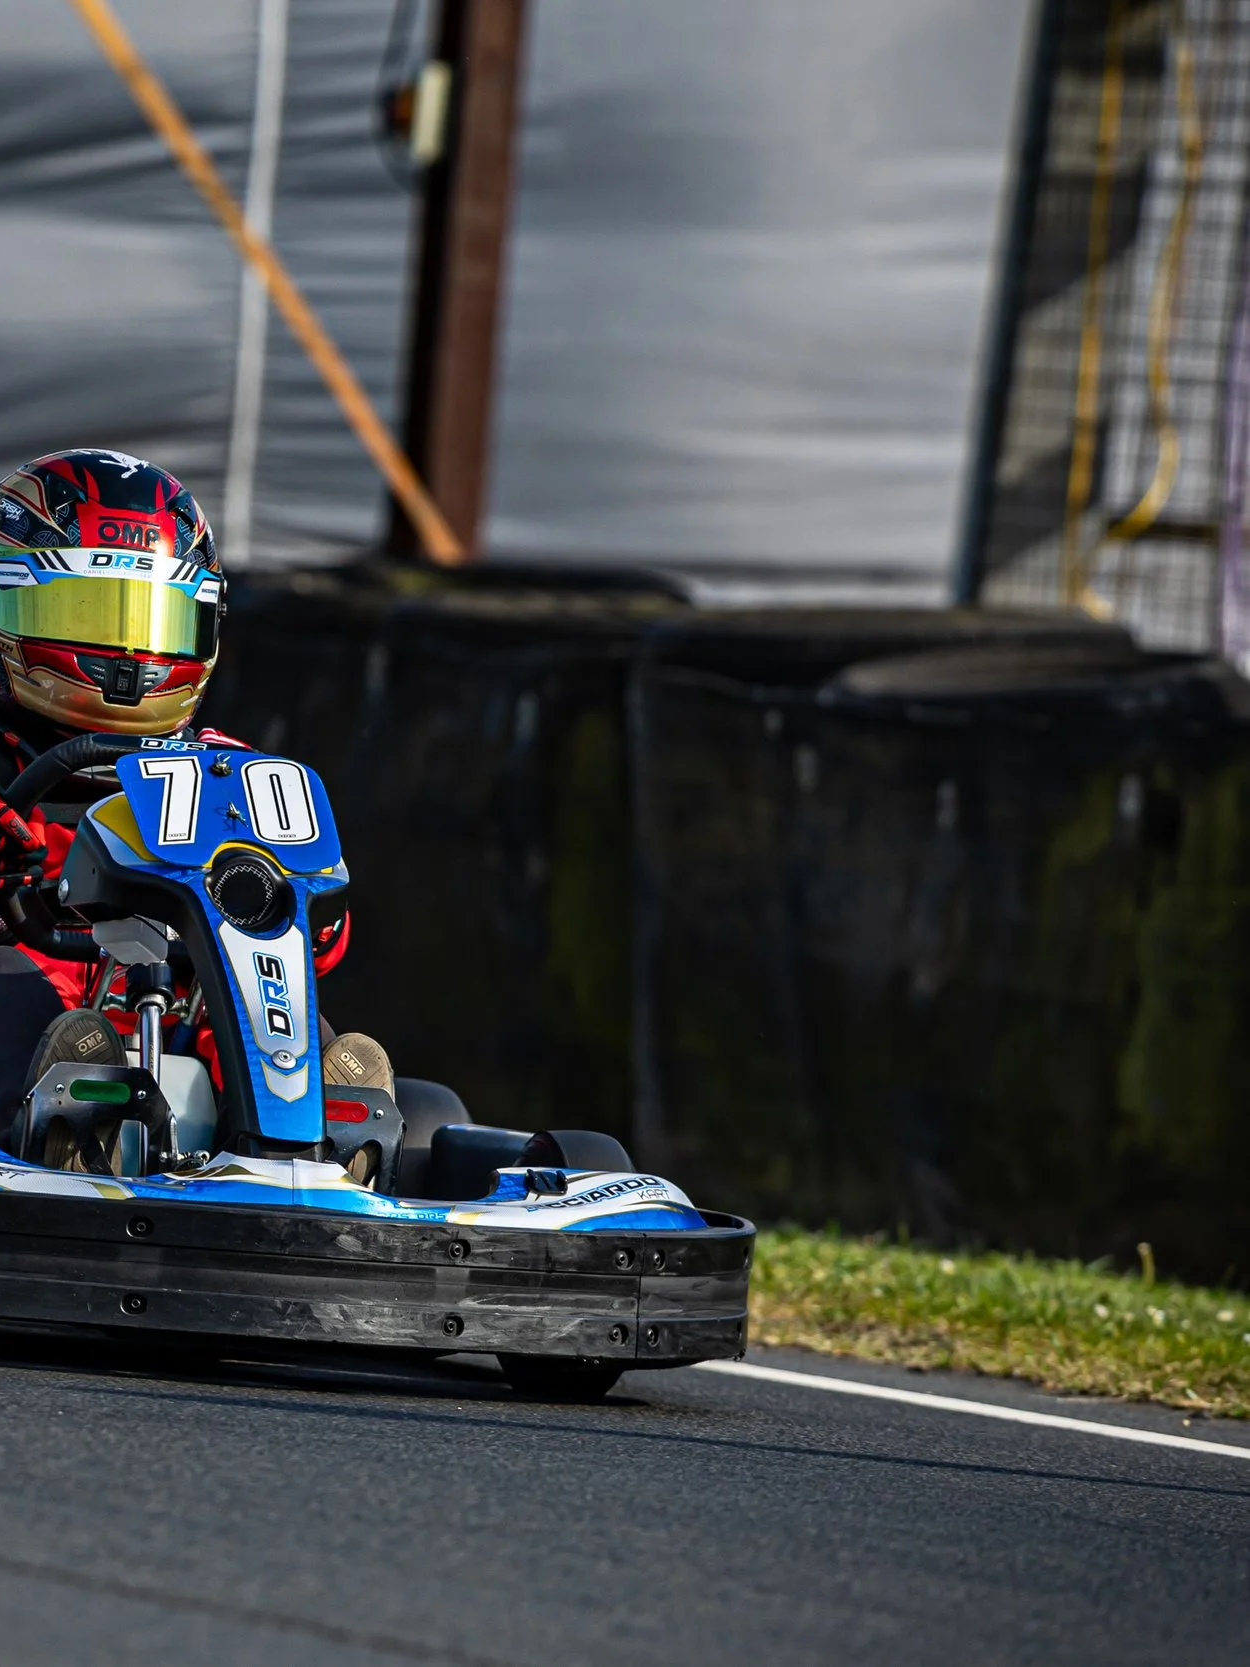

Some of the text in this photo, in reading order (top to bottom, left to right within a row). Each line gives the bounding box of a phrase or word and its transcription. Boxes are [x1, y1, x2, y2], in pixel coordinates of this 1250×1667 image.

[98, 522, 159, 547] OMP
[89, 552, 154, 571] DRS
[141, 738, 207, 751] DRS
[138, 756, 320, 846] 70
[254, 953, 294, 1039] DRS
[78, 1032, 103, 1053] OMP
[340, 1052, 363, 1075] OMP
[527, 1176, 666, 1212] ICCIARDO
[637, 1189, 671, 1201] KART
